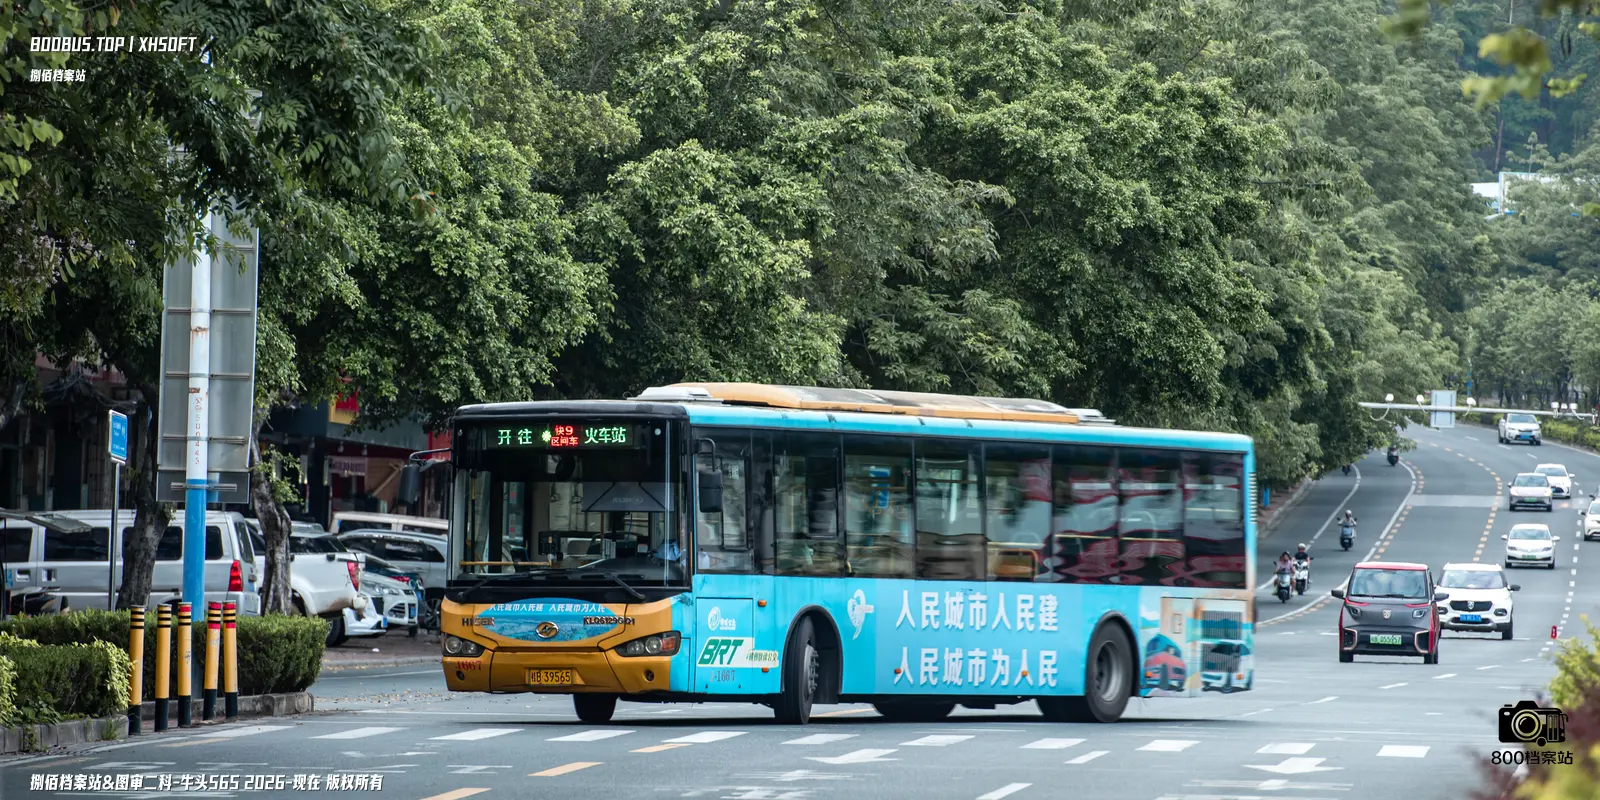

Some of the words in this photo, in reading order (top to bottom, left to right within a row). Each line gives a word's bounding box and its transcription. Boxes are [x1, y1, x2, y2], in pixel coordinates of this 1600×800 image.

[550, 435, 579, 447] 区间车
[554, 424, 574, 436] 快9
[584, 427, 627, 444] 火车站
[895, 590, 1060, 632] 人民城市人民建
[697, 638, 745, 665] BRT
[893, 647, 1059, 688] 人民城市为人民
